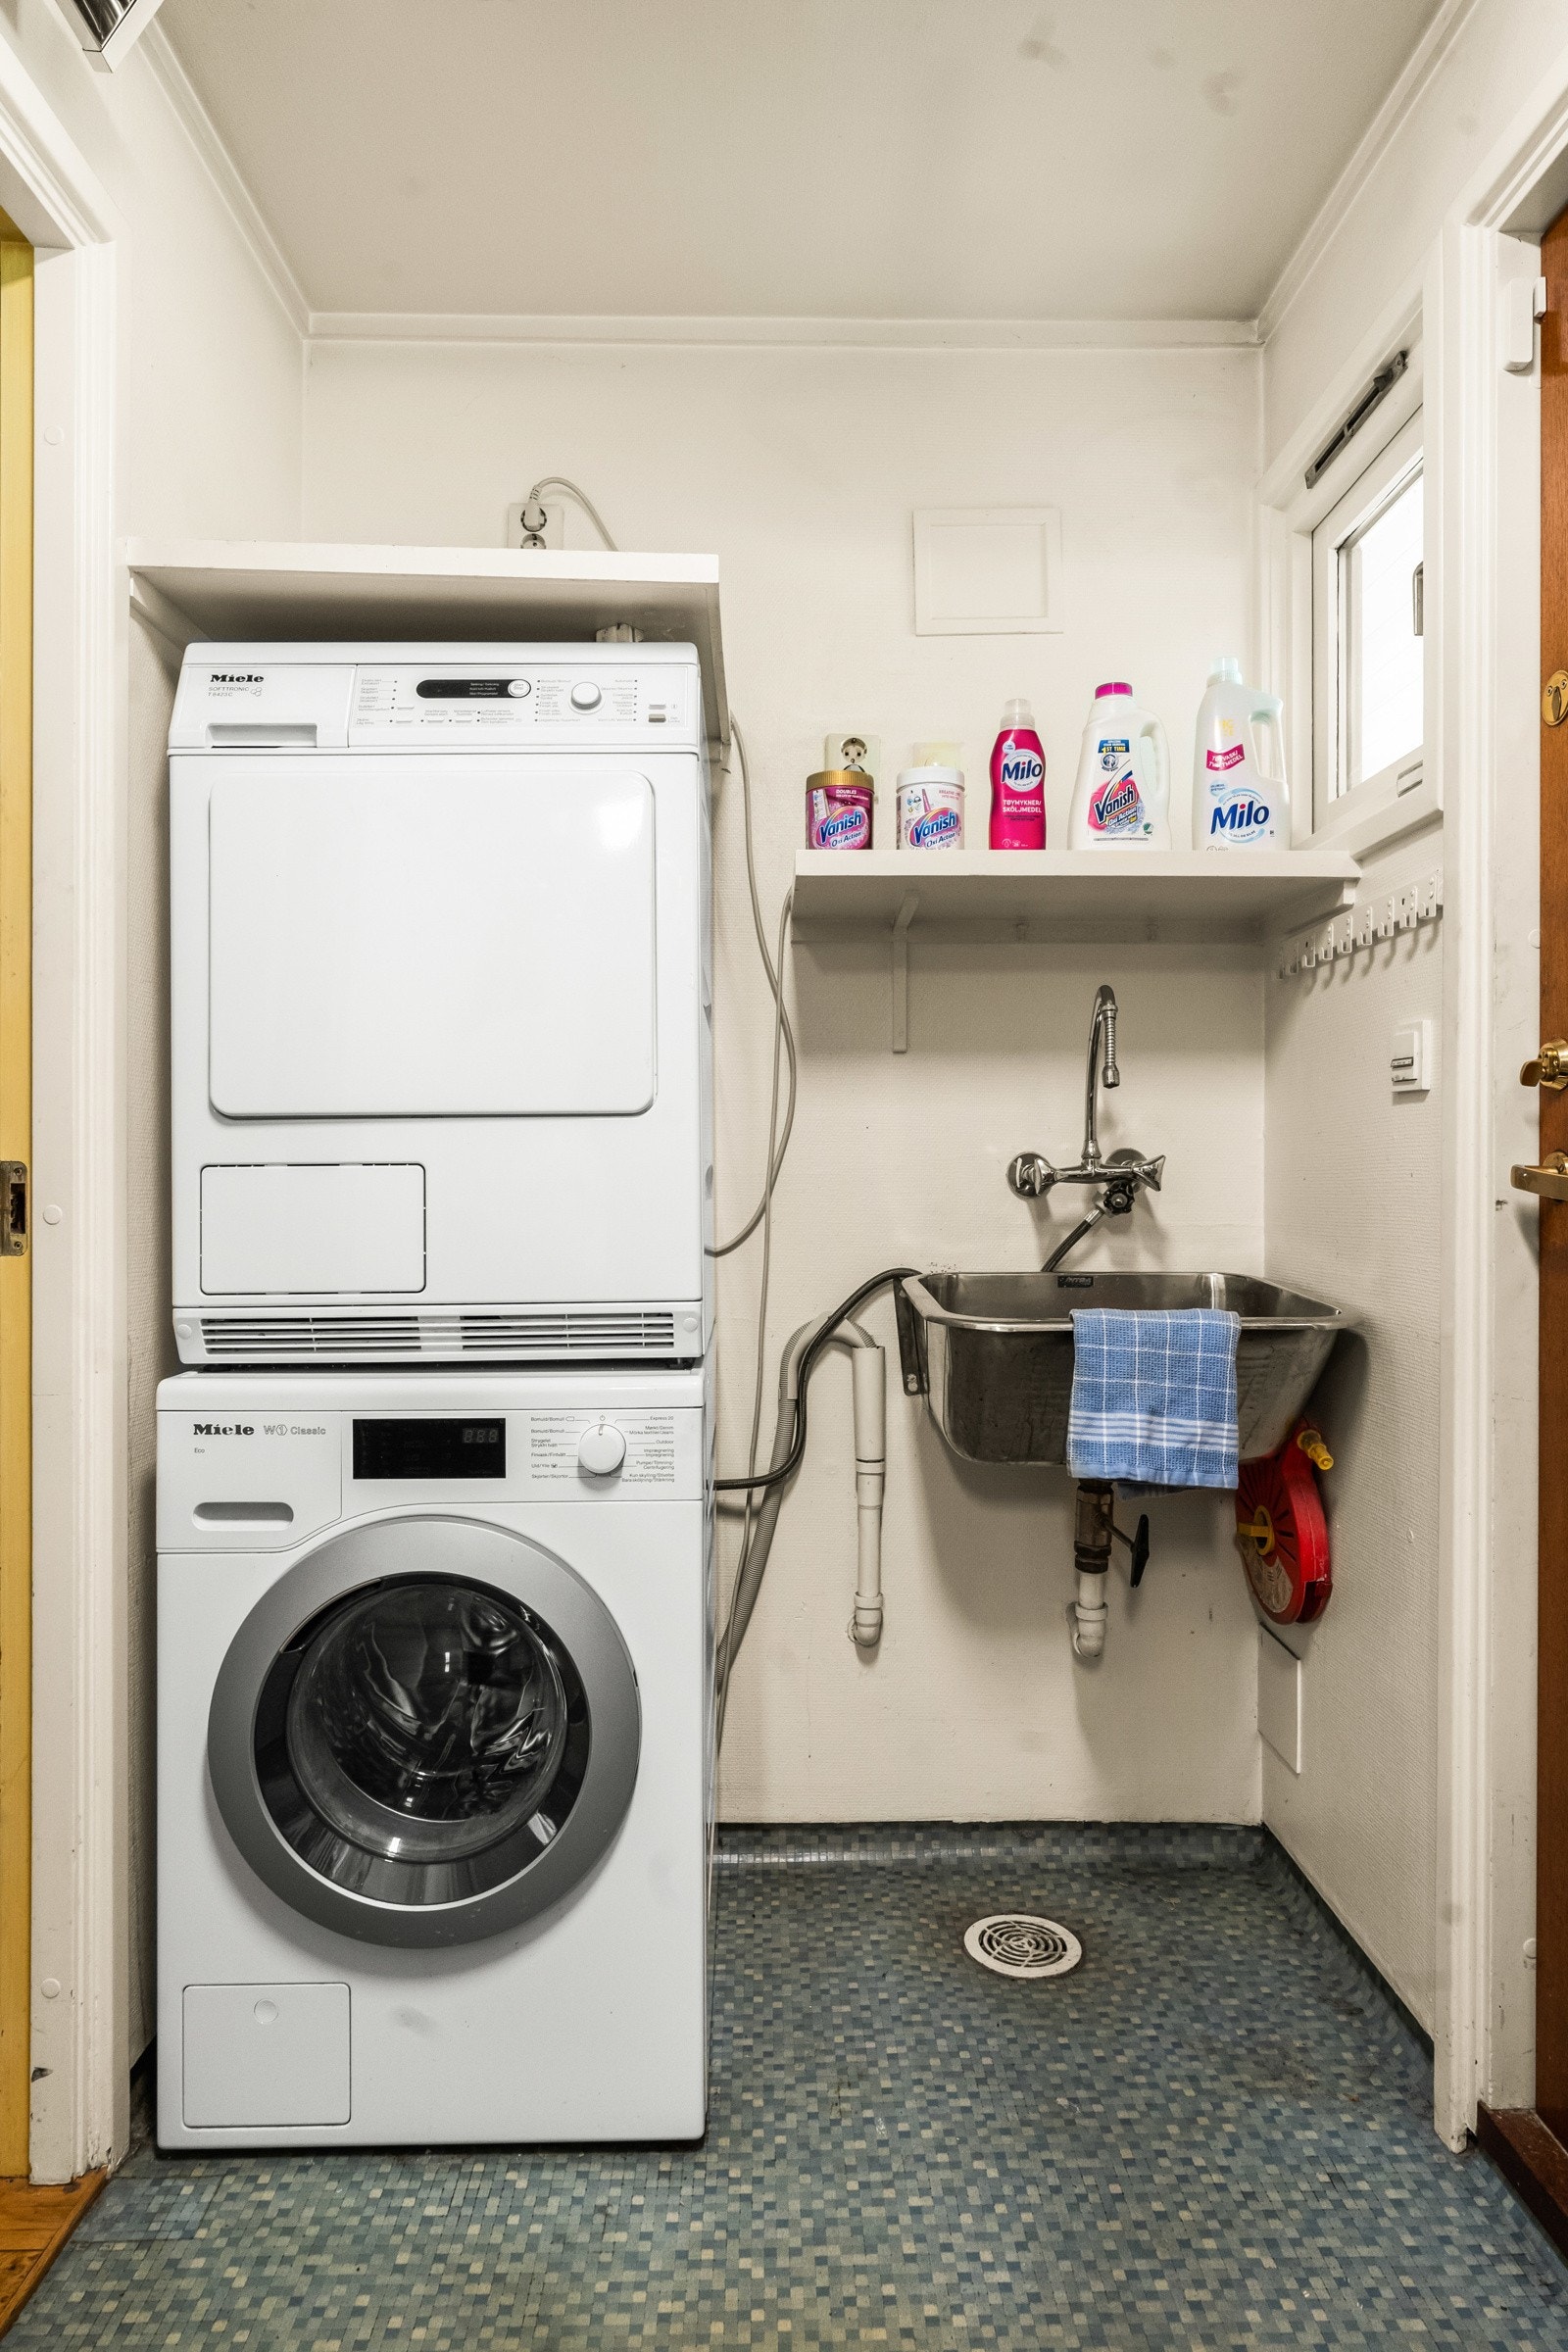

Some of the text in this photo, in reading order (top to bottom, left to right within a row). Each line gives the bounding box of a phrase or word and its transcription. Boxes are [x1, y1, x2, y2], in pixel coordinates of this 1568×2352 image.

[211, 674, 265, 683] Miele
[1002, 760, 1043, 783] Milo
[1095, 784, 1135, 824] Vanish
[819, 810, 862, 844] Vanish
[914, 811, 956, 844] Vanish
[1210, 800, 1270, 835] Milo
[843, 831, 862, 843] Action
[926, 832, 956, 848] Oxi Action
[193, 1423, 255, 1436] Miele
[290, 1426, 326, 1436] Classic
